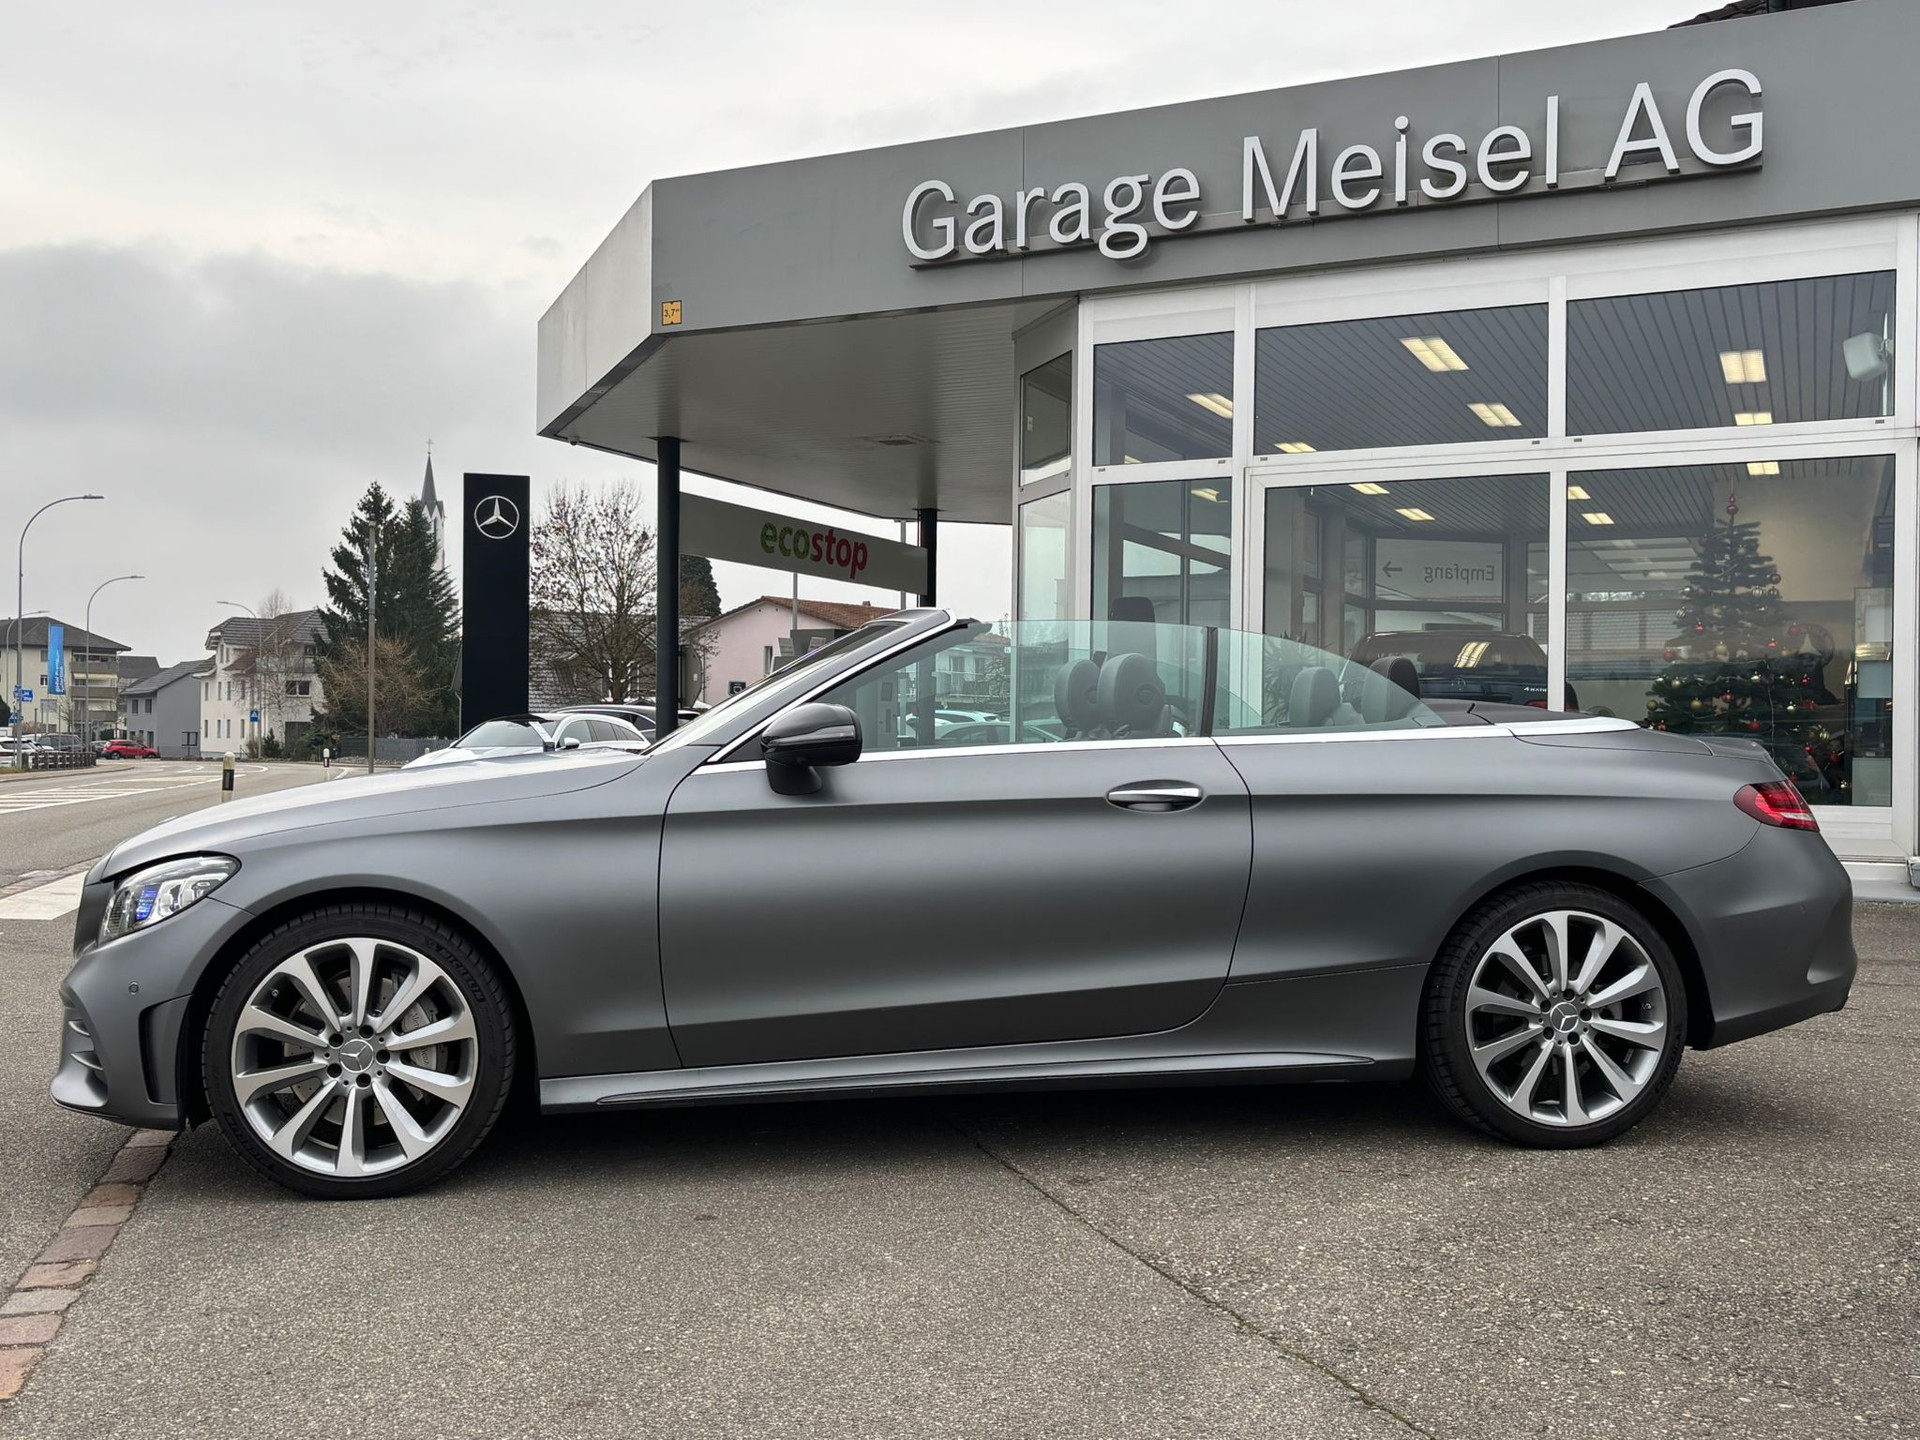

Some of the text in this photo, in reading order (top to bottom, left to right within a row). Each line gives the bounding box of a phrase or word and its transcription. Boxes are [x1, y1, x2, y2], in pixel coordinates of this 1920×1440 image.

[902, 68, 1762, 259] Garage Meisel AG
[760, 522, 868, 579] ecostop
